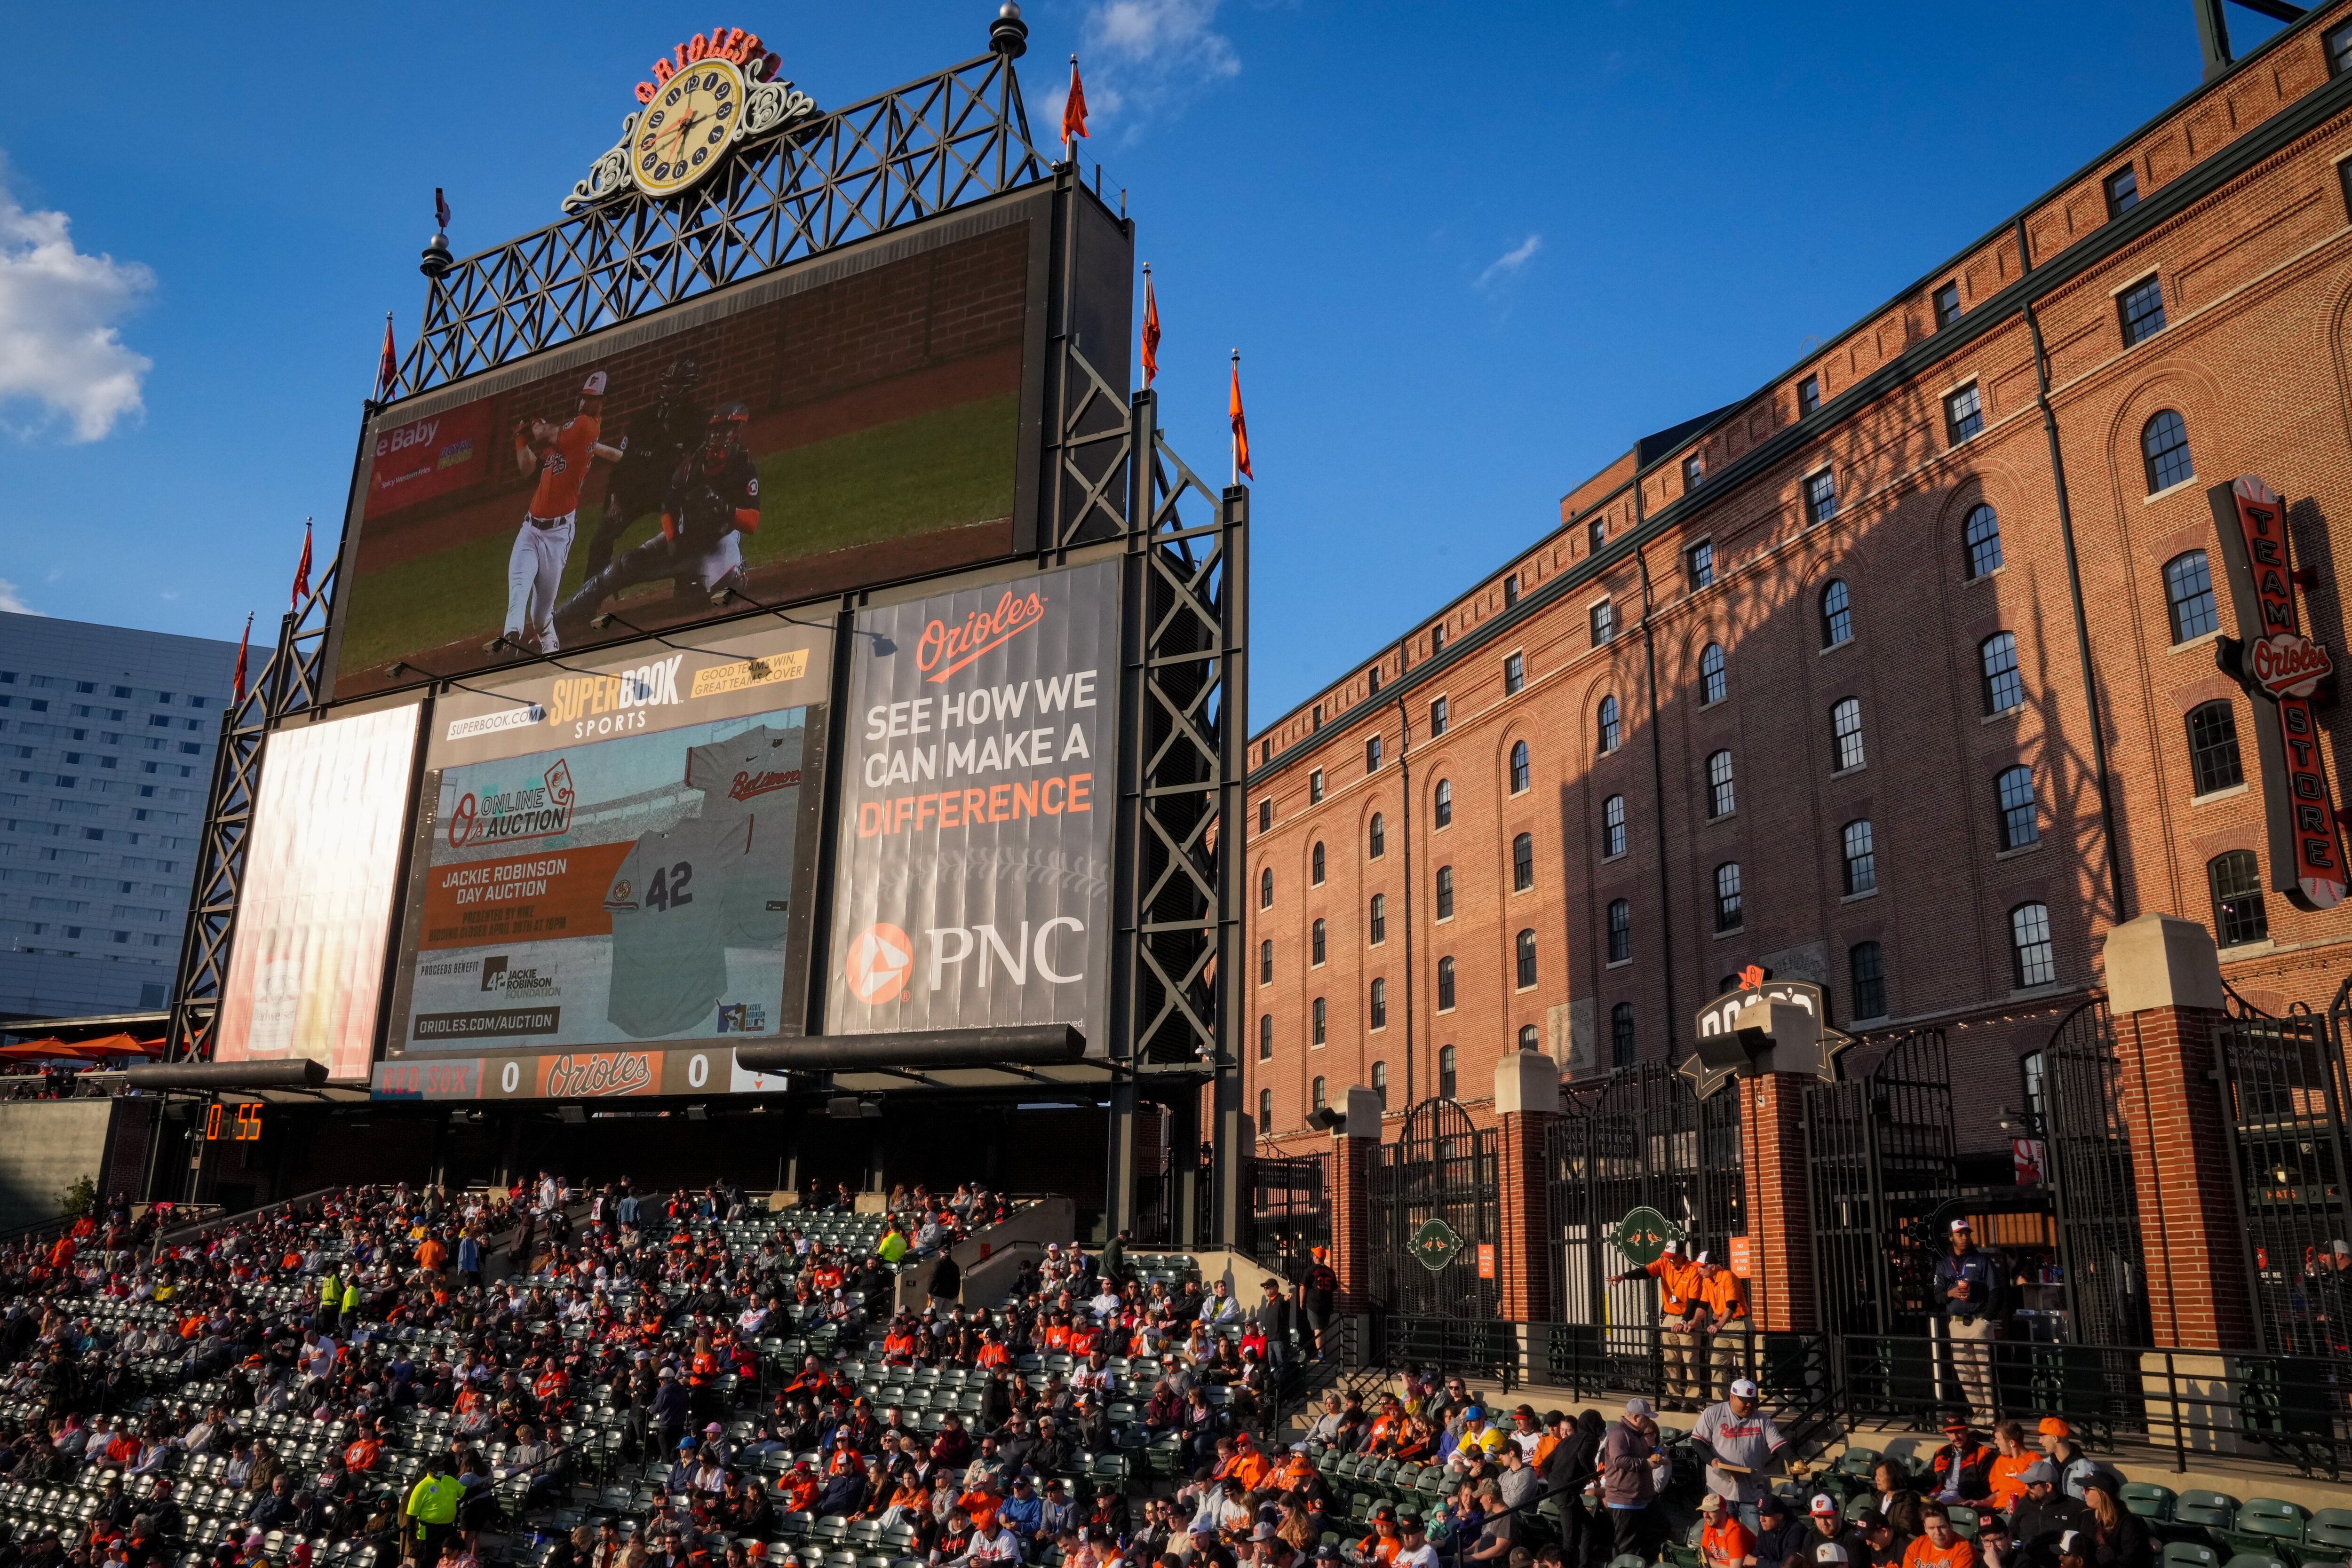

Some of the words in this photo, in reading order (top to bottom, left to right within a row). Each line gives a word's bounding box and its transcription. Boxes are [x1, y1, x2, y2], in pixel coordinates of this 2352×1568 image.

[635, 27, 763, 104] ORIOLES
[687, 75, 699, 93] 12
[707, 74, 715, 89] 1
[717, 85, 729, 99] 2
[667, 90, 680, 105] 11
[651, 113, 663, 126] 10
[718, 103, 731, 117] 3
[711, 128, 722, 141] 4
[644, 155, 656, 169] 8
[696, 149, 705, 162] 5
[658, 164, 668, 178] 7
[676, 163, 685, 176] 6
[391, 420, 439, 452] Baby
[381, 479, 395, 489] Spicy
[395, 471, 418, 483] Western
[418, 467, 431, 476] Fries
[2247, 507, 2291, 629] TEAM
[916, 591, 1044, 683] Orioles
[702, 666, 734, 681] GOOD
[737, 658, 770, 674] TEAMS
[773, 654, 796, 669] WIN,
[2255, 638, 2331, 690] Orioles
[549, 654, 683, 727] SUPERBOOK
[695, 681, 726, 695] GREAT
[729, 673, 762, 690] TEAMS
[765, 665, 803, 681] COVER
[865, 697, 932, 740] SEE
[941, 681, 1029, 729] HOW
[1035, 669, 1097, 713] WE
[450, 708, 538, 736] SUPERBOOK.COM
[574, 710, 646, 739] SPORTS
[865, 744, 937, 788] CAN
[946, 727, 1054, 777] MAKE
[1061, 723, 1090, 762] A
[2286, 707, 2333, 868] STORE
[481, 787, 546, 816] ONLINE
[859, 773, 1092, 838] DIFFERENCE
[486, 807, 566, 838] AUCTION
[442, 868, 491, 887] JACKIE
[494, 858, 567, 882] ROBINSON
[456, 887, 480, 904] DAY
[485, 879, 547, 901] AUCTION
[646, 861, 692, 912] 42
[506, 908, 516, 919] BY
[489, 922, 509, 935] APRIL
[534, 919, 544, 931] AT
[925, 917, 1084, 991] PNC
[421, 963, 452, 976] PROCEEDS
[453, 961, 479, 974] BENEFIT
[508, 969, 537, 980] JACKIE
[506, 987, 562, 999] FOUNDATION
[507, 977, 551, 990] ROBINSON
[254, 1008, 294, 1022] Budweiser
[420, 1014, 552, 1033] ORIOLES.COM/AUCTION
[382, 1067, 420, 1094] RED
[427, 1066, 469, 1093] SOX
[502, 1061, 519, 1093] 0
[547, 1052, 651, 1097] Orioles
[689, 1054, 708, 1088] 0
[1317, 1276, 1331, 1291] 35
[1676, 1448, 1687, 1458] 98
